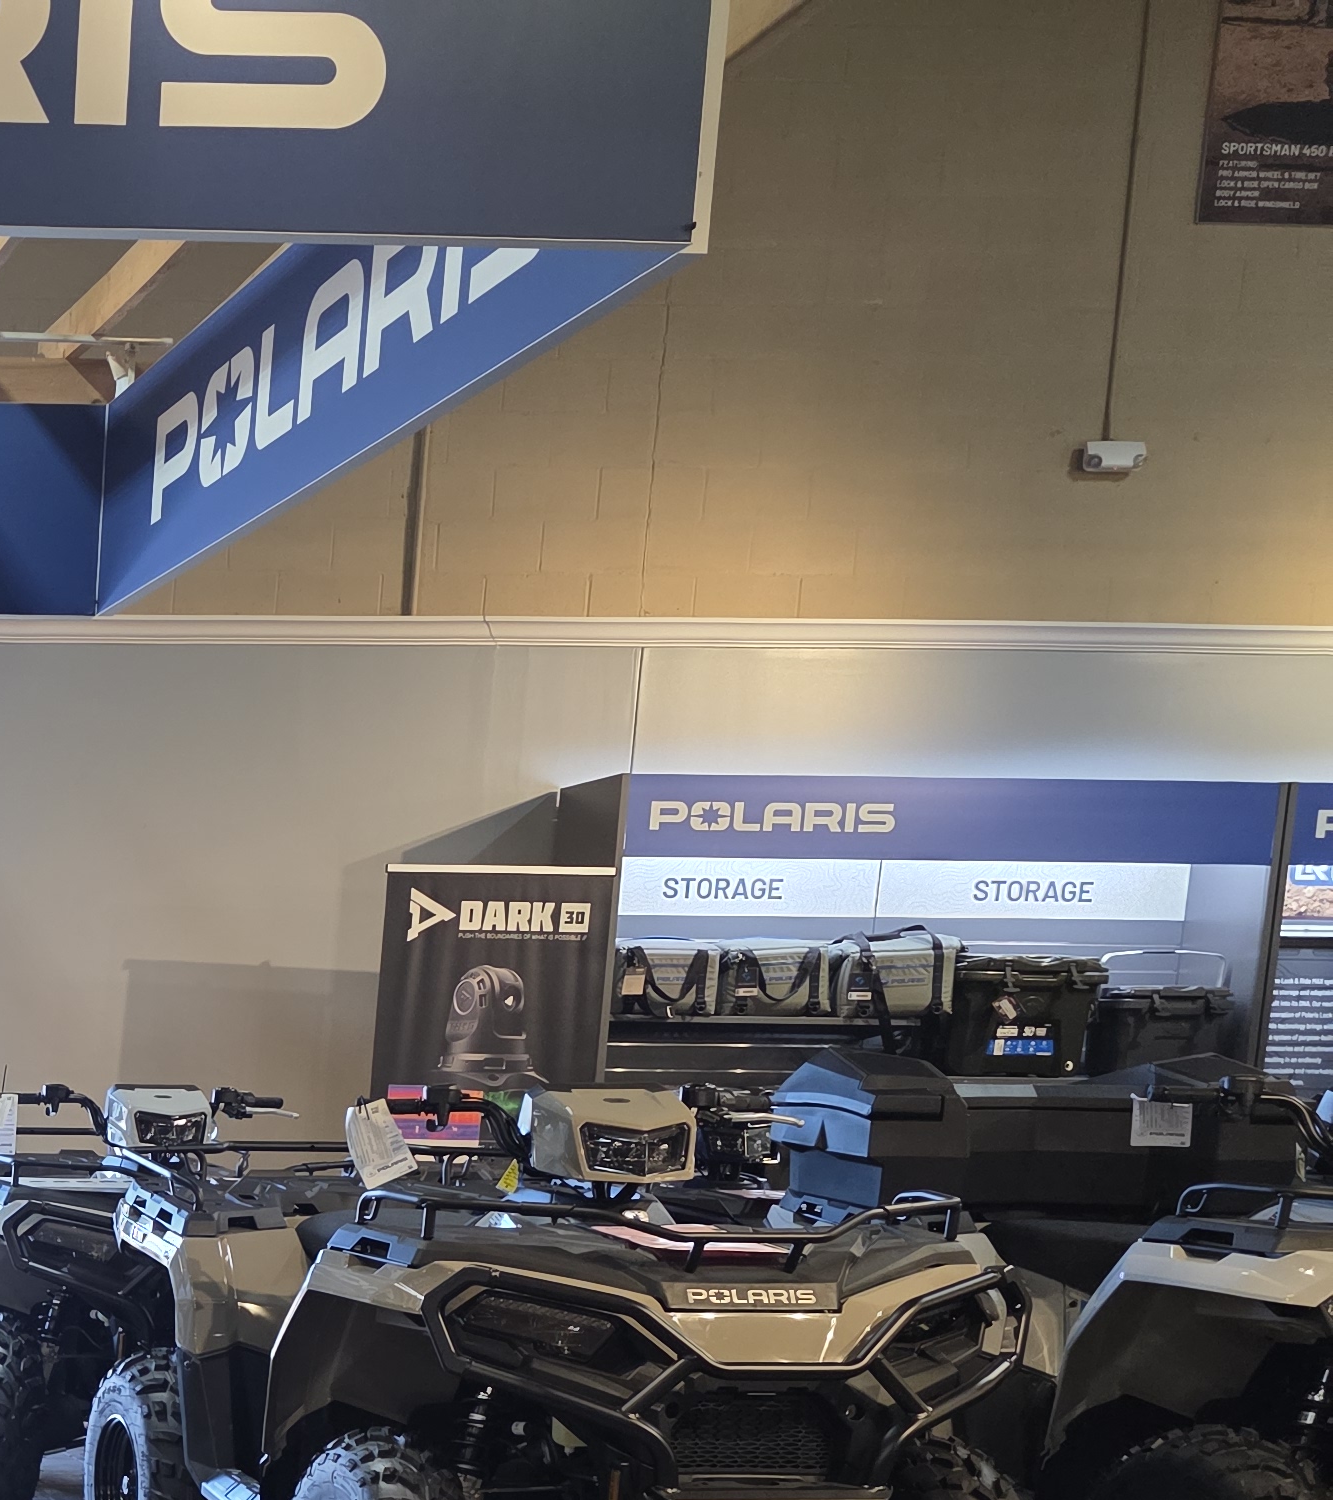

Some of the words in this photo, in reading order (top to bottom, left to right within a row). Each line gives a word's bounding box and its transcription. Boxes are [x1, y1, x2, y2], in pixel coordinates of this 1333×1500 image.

[1221, 142, 1300, 156] SPORTSMAN
[1303, 145, 1328, 157] 450
[649, 800, 896, 834] POLARIS
[662, 876, 784, 901] STORAGE
[972, 879, 1094, 904] STORAGE
[459, 900, 556, 932] DARK
[686, 1288, 817, 1304] POLARIS
